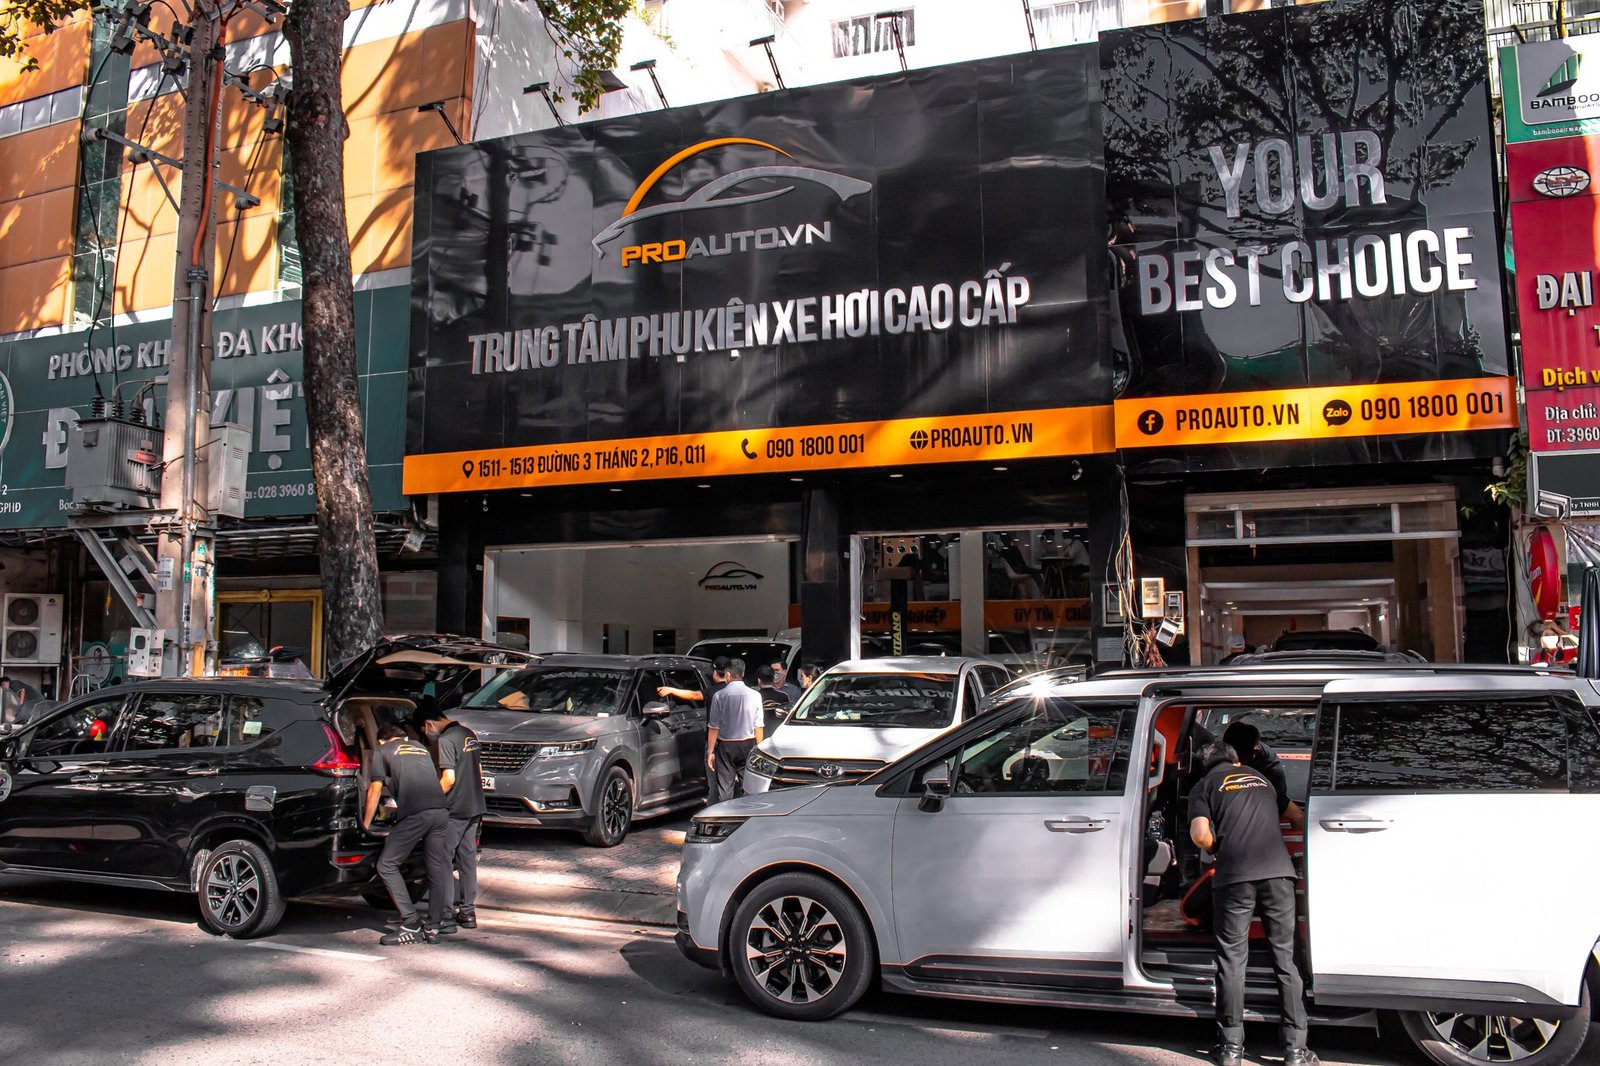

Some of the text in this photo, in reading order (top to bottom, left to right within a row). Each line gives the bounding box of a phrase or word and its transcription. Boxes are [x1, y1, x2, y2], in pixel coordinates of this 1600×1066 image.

[1209, 129, 1387, 218] YOUR
[621, 220, 832, 268] PROAUTO.VN
[1138, 226, 1478, 316] BEST CHOICE
[1536, 271, 1594, 316] ĐẠI
[468, 262, 1030, 375] TRUNG TÂM PHỤ KIỆN XE HƠI CAO CẤP
[48, 342, 132, 380] PHÒNG
[137, 340, 171, 368] KH
[218, 328, 254, 359] ĐA
[1542, 366, 1588, 391] Dịch
[1176, 402, 1300, 431] PROAUTO.VN
[1326, 407, 1349, 418] Zalo
[1361, 397, 1401, 421] 090
[1408, 393, 1458, 418] 1800
[1466, 391, 1504, 415] 001
[1545, 403, 1597, 423] Địa chỉ:
[766, 433, 865, 459] 090 1800 001
[930, 422, 1033, 449] PROAUTO.VN
[479, 459, 501, 478] 1511
[509, 457, 534, 475] 1513
[537, 452, 579, 473] ĐƯỜNG
[582, 453, 591, 470] 3
[595, 446, 636, 470] THÁNG
[685, 444, 706, 464] Q11
[257, 486, 277, 499] 028
[279, 483, 305, 497] 3960
